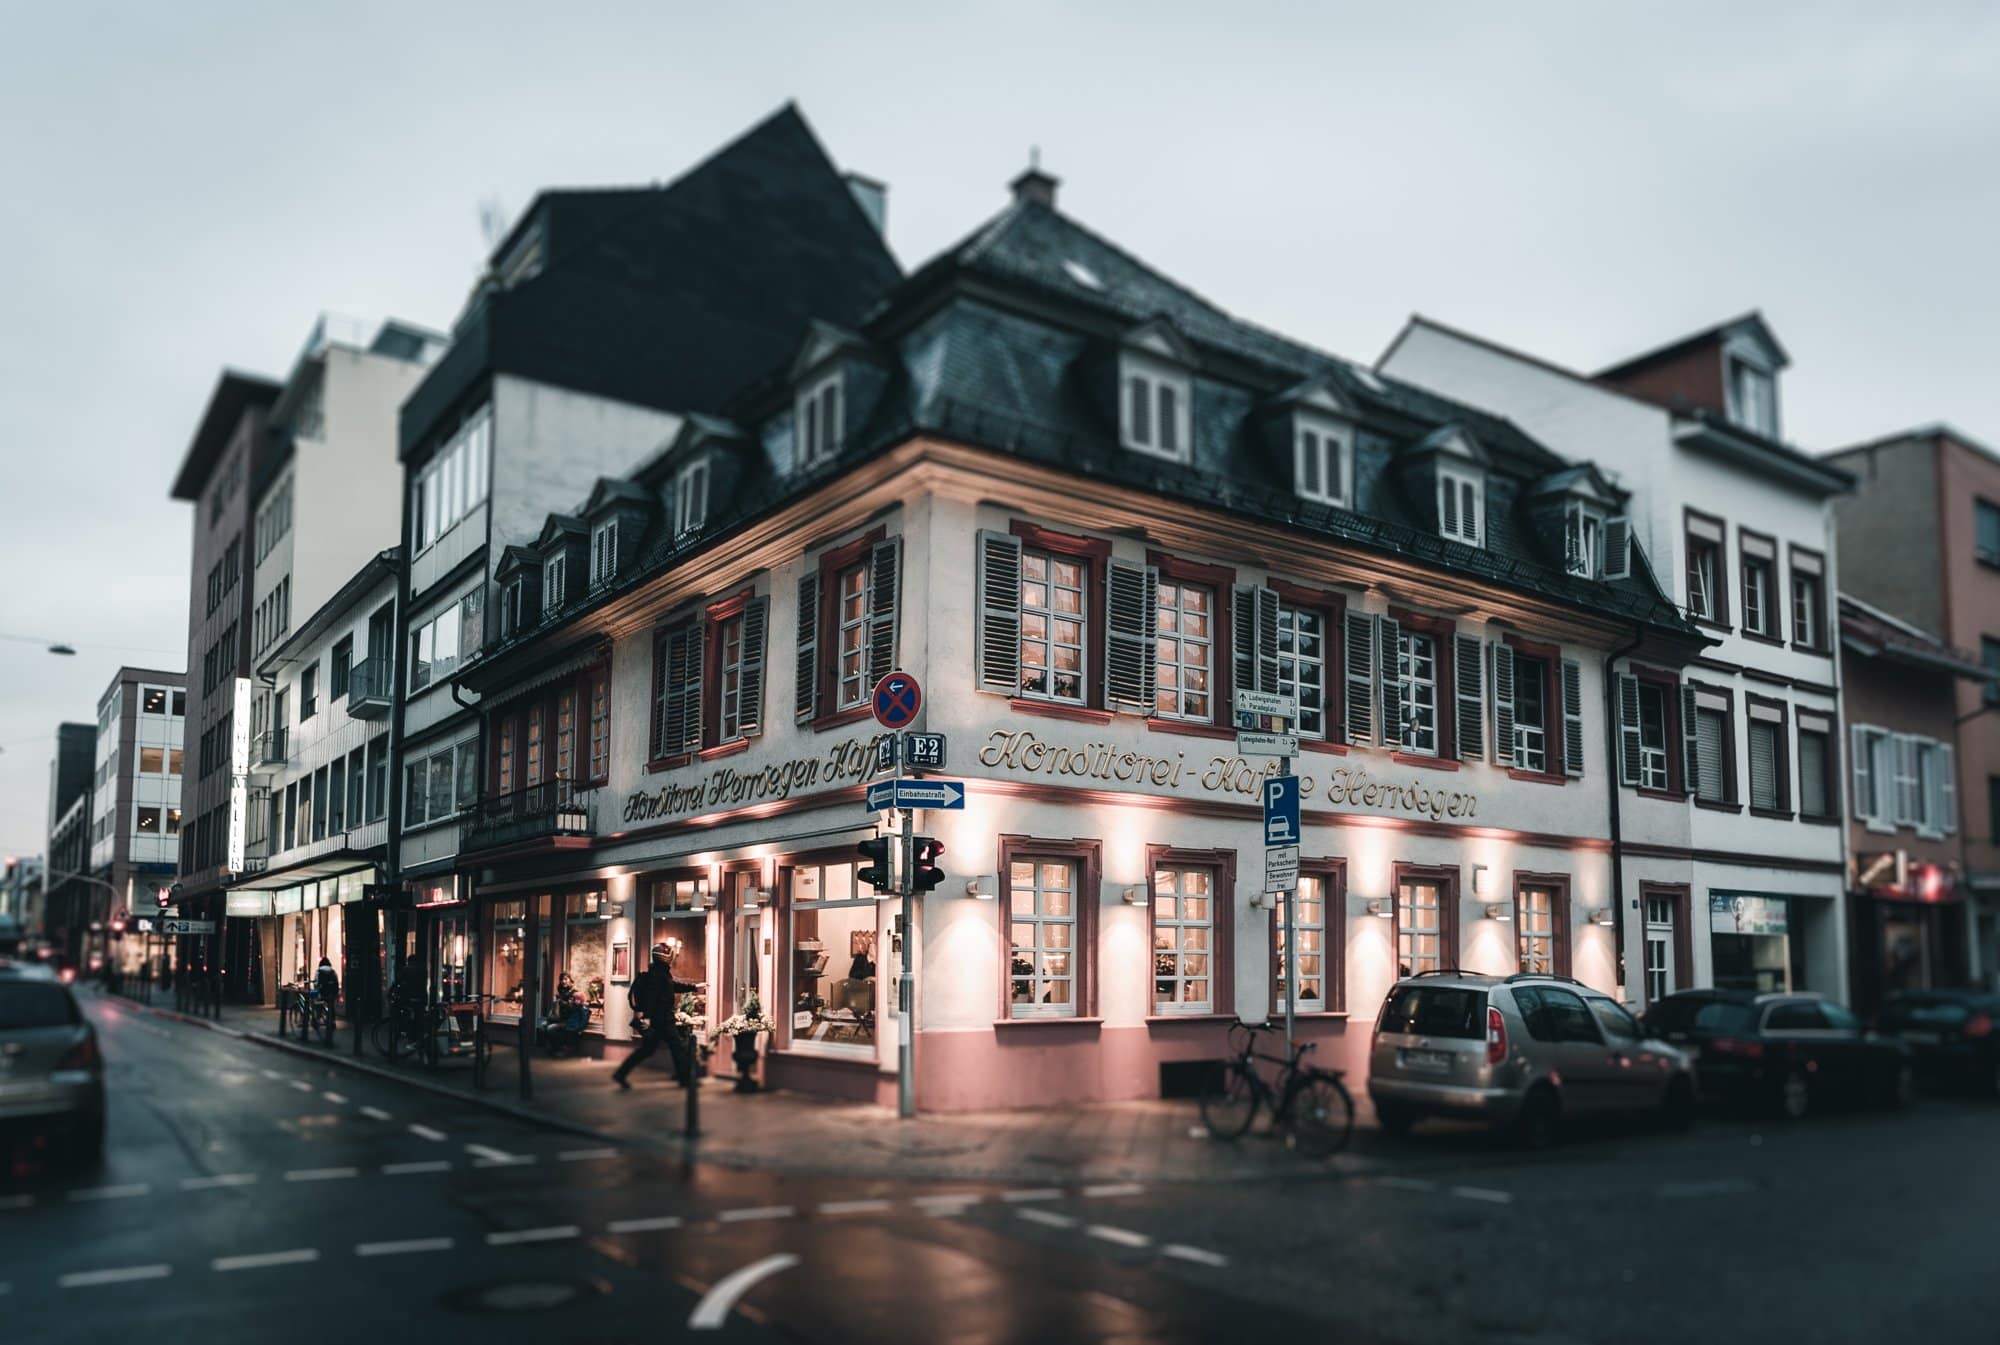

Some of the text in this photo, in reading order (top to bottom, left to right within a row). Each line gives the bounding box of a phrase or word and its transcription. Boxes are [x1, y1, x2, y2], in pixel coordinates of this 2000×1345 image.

[979, 728, 1185, 788] Konditorei
[1201, 756, 1315, 802] Kafe
[1327, 767, 1477, 821] Herrdegen
[623, 778, 708, 823] Konditorei
[708, 757, 820, 800] Herrdegen
[899, 790, 946, 799] Einbahnstraße
[1269, 783, 1285, 809] P
[1268, 859, 1297, 868] Parkschein
[1269, 871, 1295, 880] Bewohner
